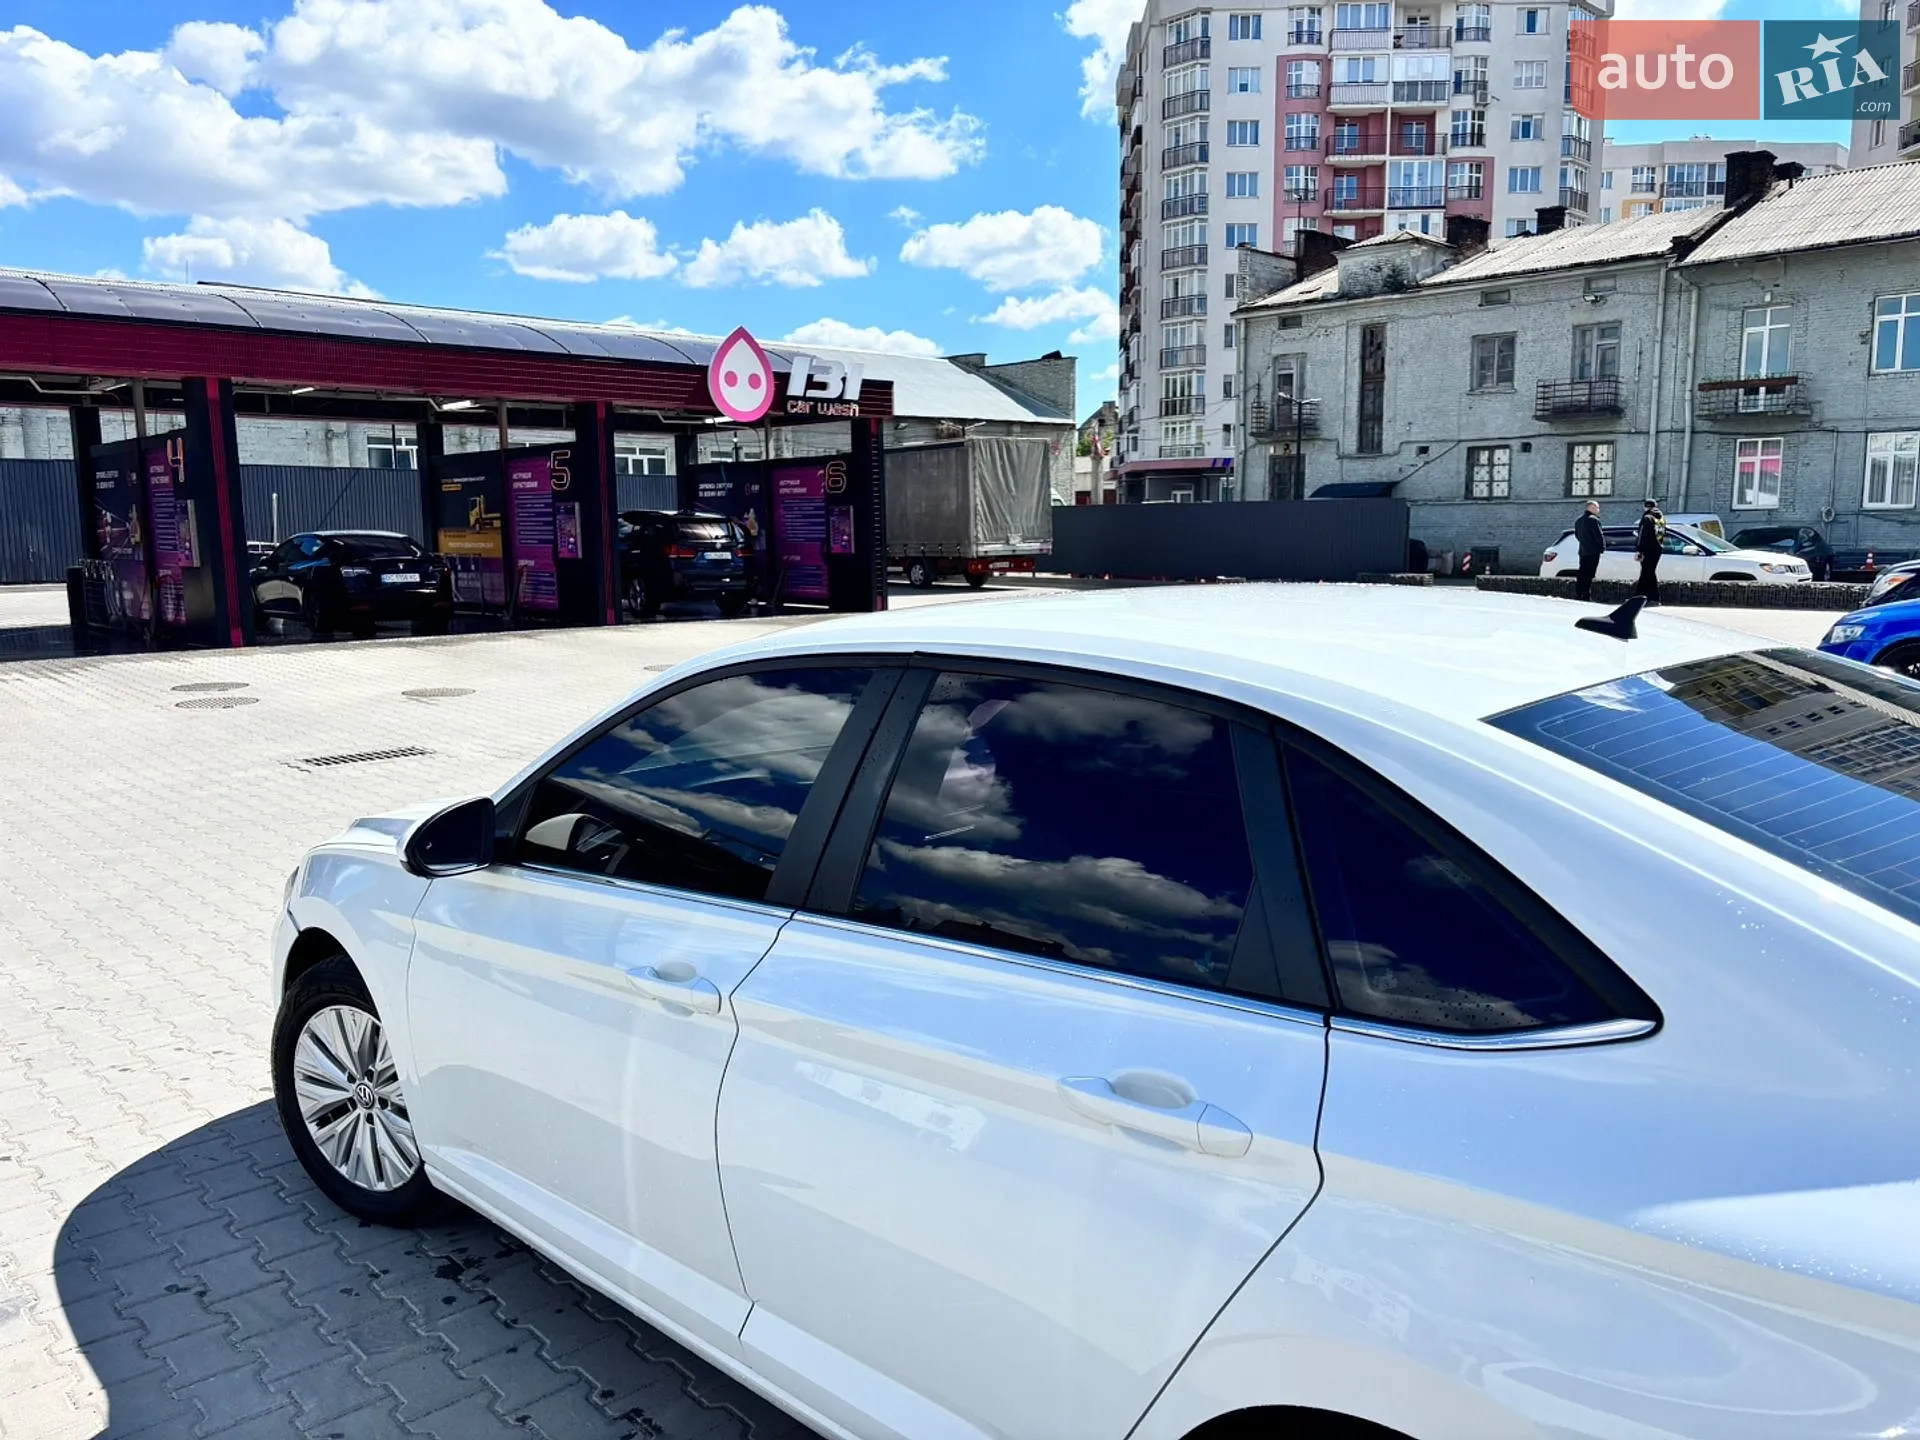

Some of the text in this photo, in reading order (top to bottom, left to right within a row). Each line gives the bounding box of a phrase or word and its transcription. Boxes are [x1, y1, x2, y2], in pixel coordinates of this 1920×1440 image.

[166, 437, 185, 483] 4
[550, 449, 571, 491] 5
[825, 460, 847, 494] 6
